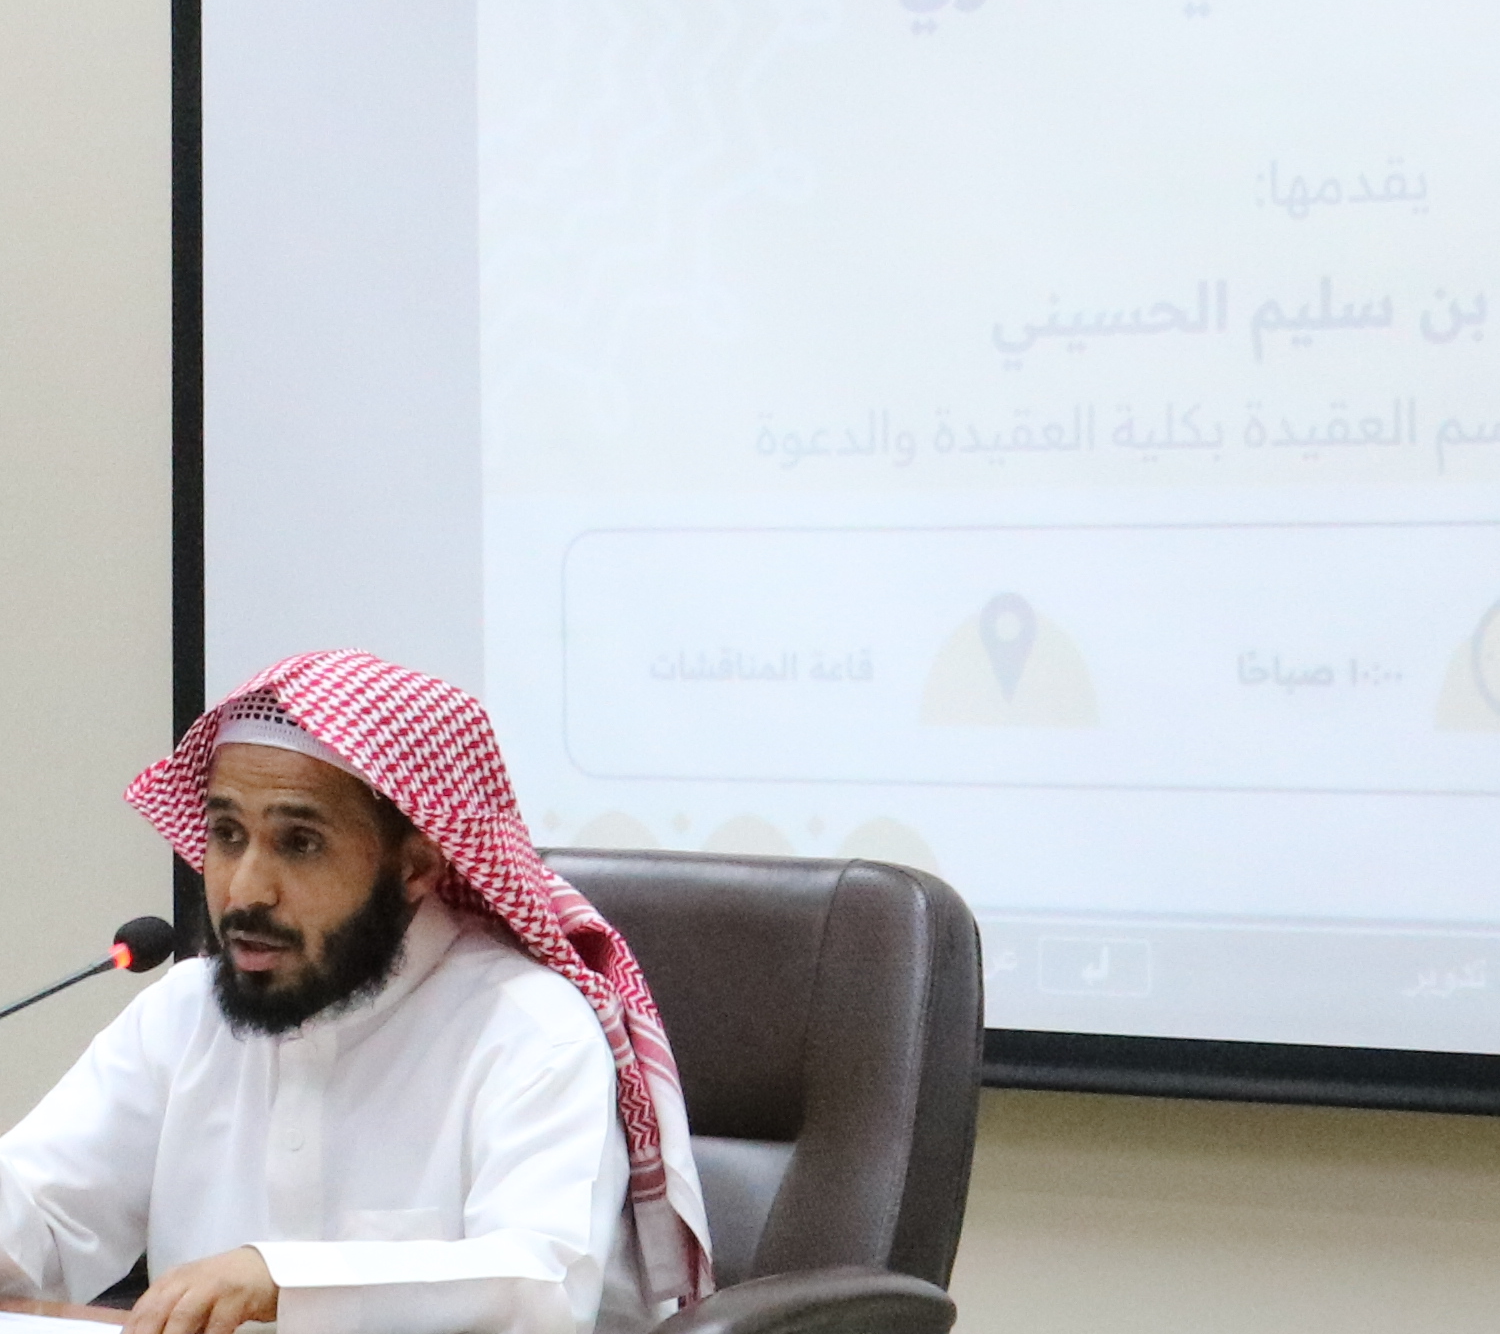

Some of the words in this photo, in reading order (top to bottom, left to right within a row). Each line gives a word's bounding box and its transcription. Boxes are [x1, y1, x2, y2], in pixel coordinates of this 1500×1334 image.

[1256, 157, 1429, 219] يقدمها:
[992, 279, 1227, 371] الحسيني
[1252, 276, 1393, 363] سليم
[1420, 288, 1487, 344] بن
[755, 409, 915, 467] والدعوة
[933, 404, 1096, 464] العقيدة
[1112, 402, 1223, 462] بكلية
[1243, 397, 1417, 460] العقيدة
[650, 648, 797, 681] المناقشات
[809, 646, 874, 681] قاعة
